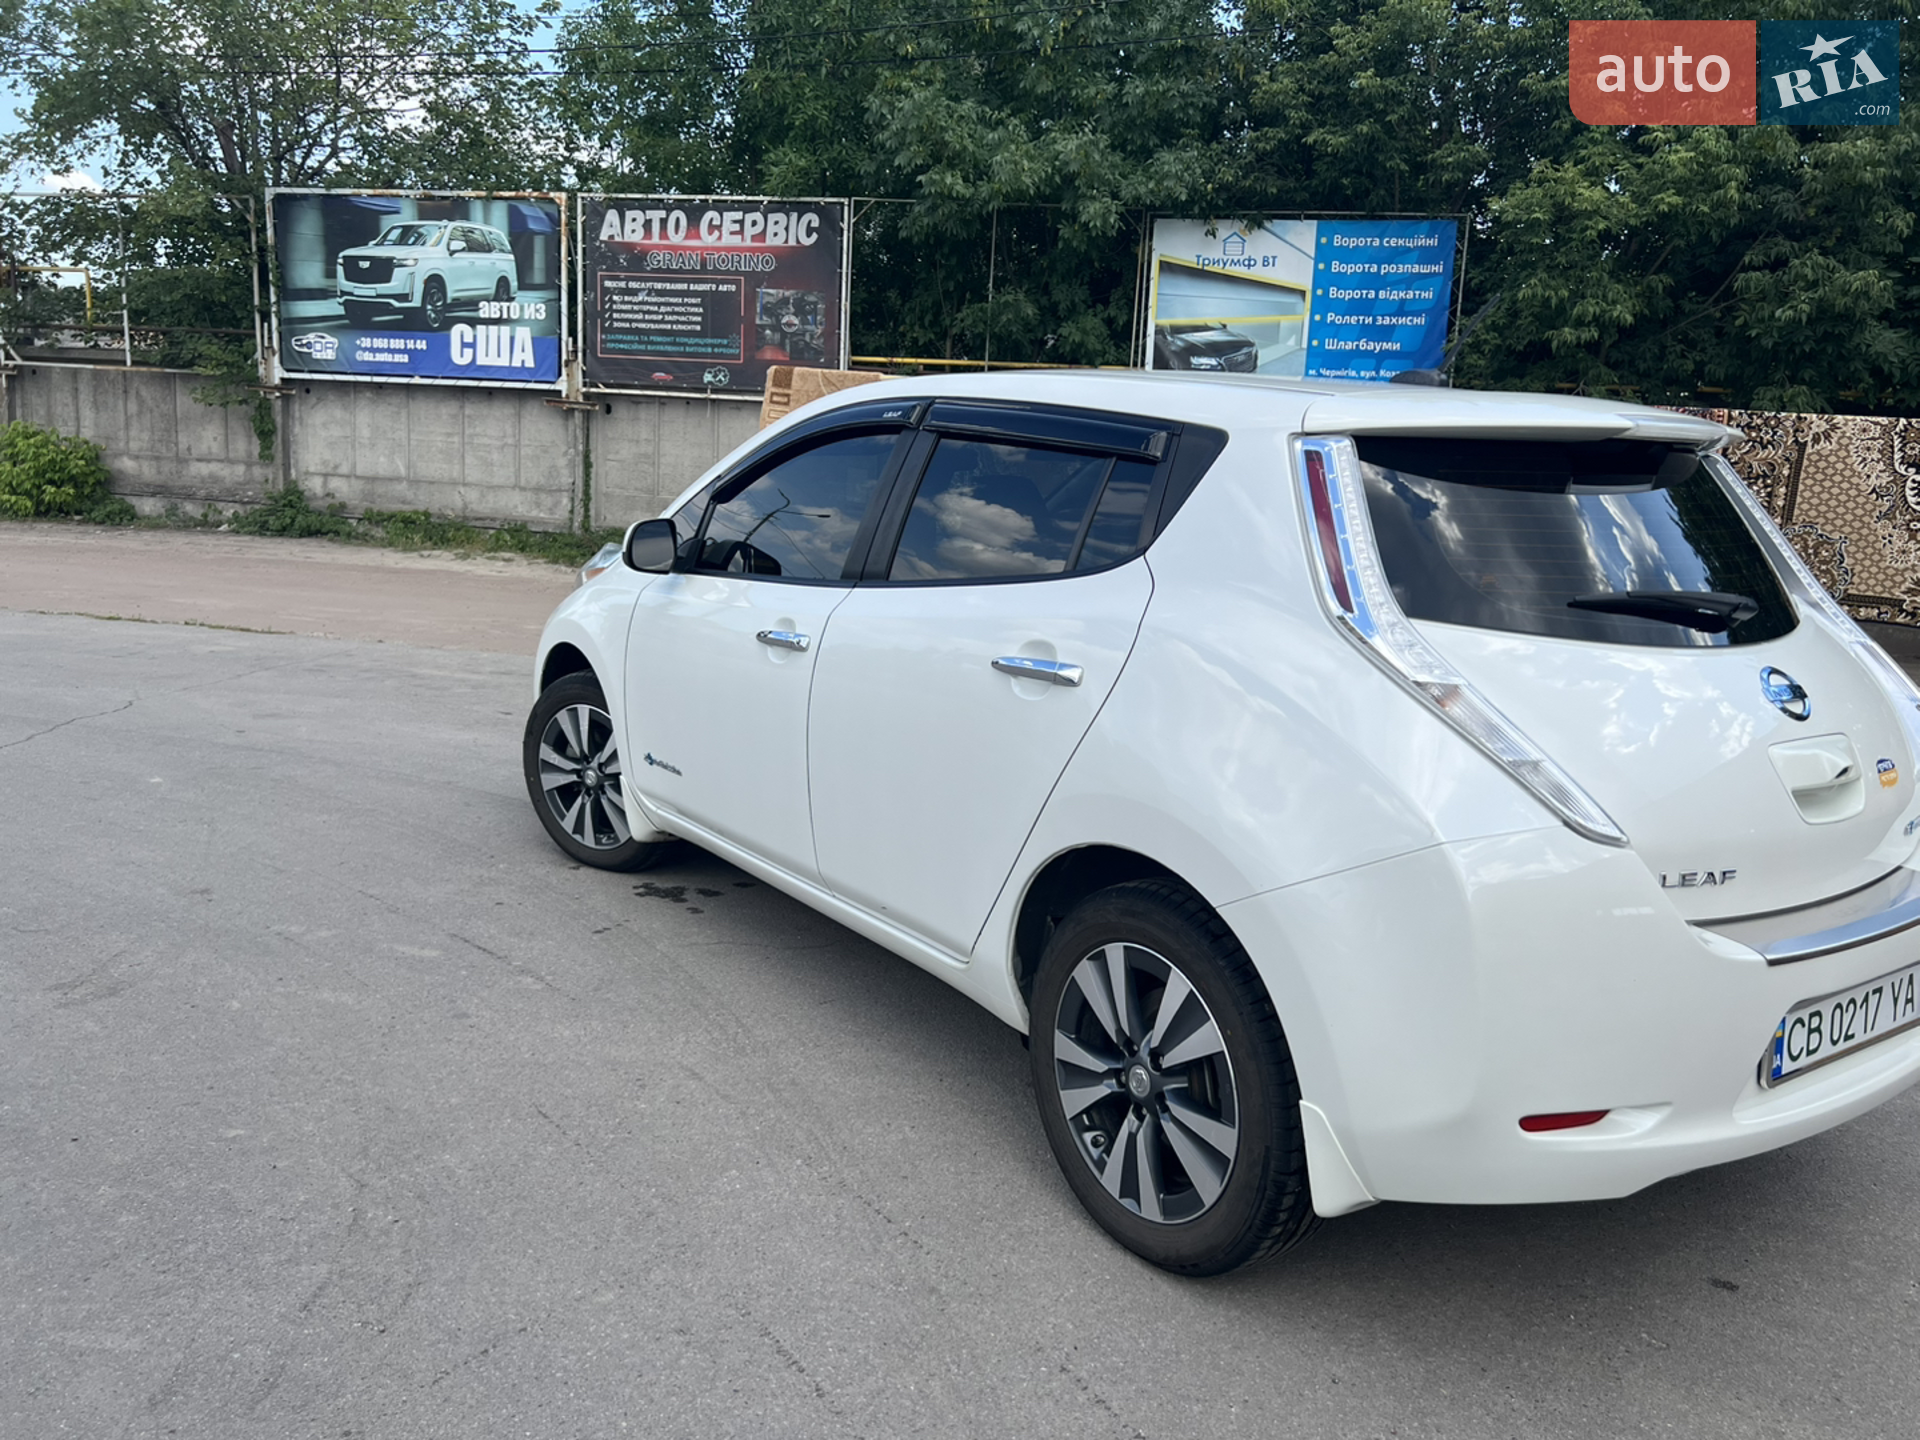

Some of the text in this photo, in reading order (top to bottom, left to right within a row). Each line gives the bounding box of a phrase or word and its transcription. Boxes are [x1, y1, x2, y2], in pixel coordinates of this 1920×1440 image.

[600, 208, 820, 247] АВТО СЕРВІС
[1333, 234, 1439, 249] Ворота секційні
[647, 250, 776, 271] GRAN TORINO
[1195, 254, 1278, 270] Триумф ВТ
[1331, 261, 1444, 276] Ворота розпашні
[718, 284, 737, 292] АВТО
[1329, 287, 1434, 302] Ворота відкатні
[478, 301, 546, 321] авто из
[1327, 313, 1426, 326] Ролети захисні
[356, 337, 371, 348] +38
[450, 322, 535, 368] США
[1324, 338, 1401, 352] Шлагбауми
[1659, 868, 1737, 888] LEAF
[1787, 973, 1915, 1062] CB 0217 YA
